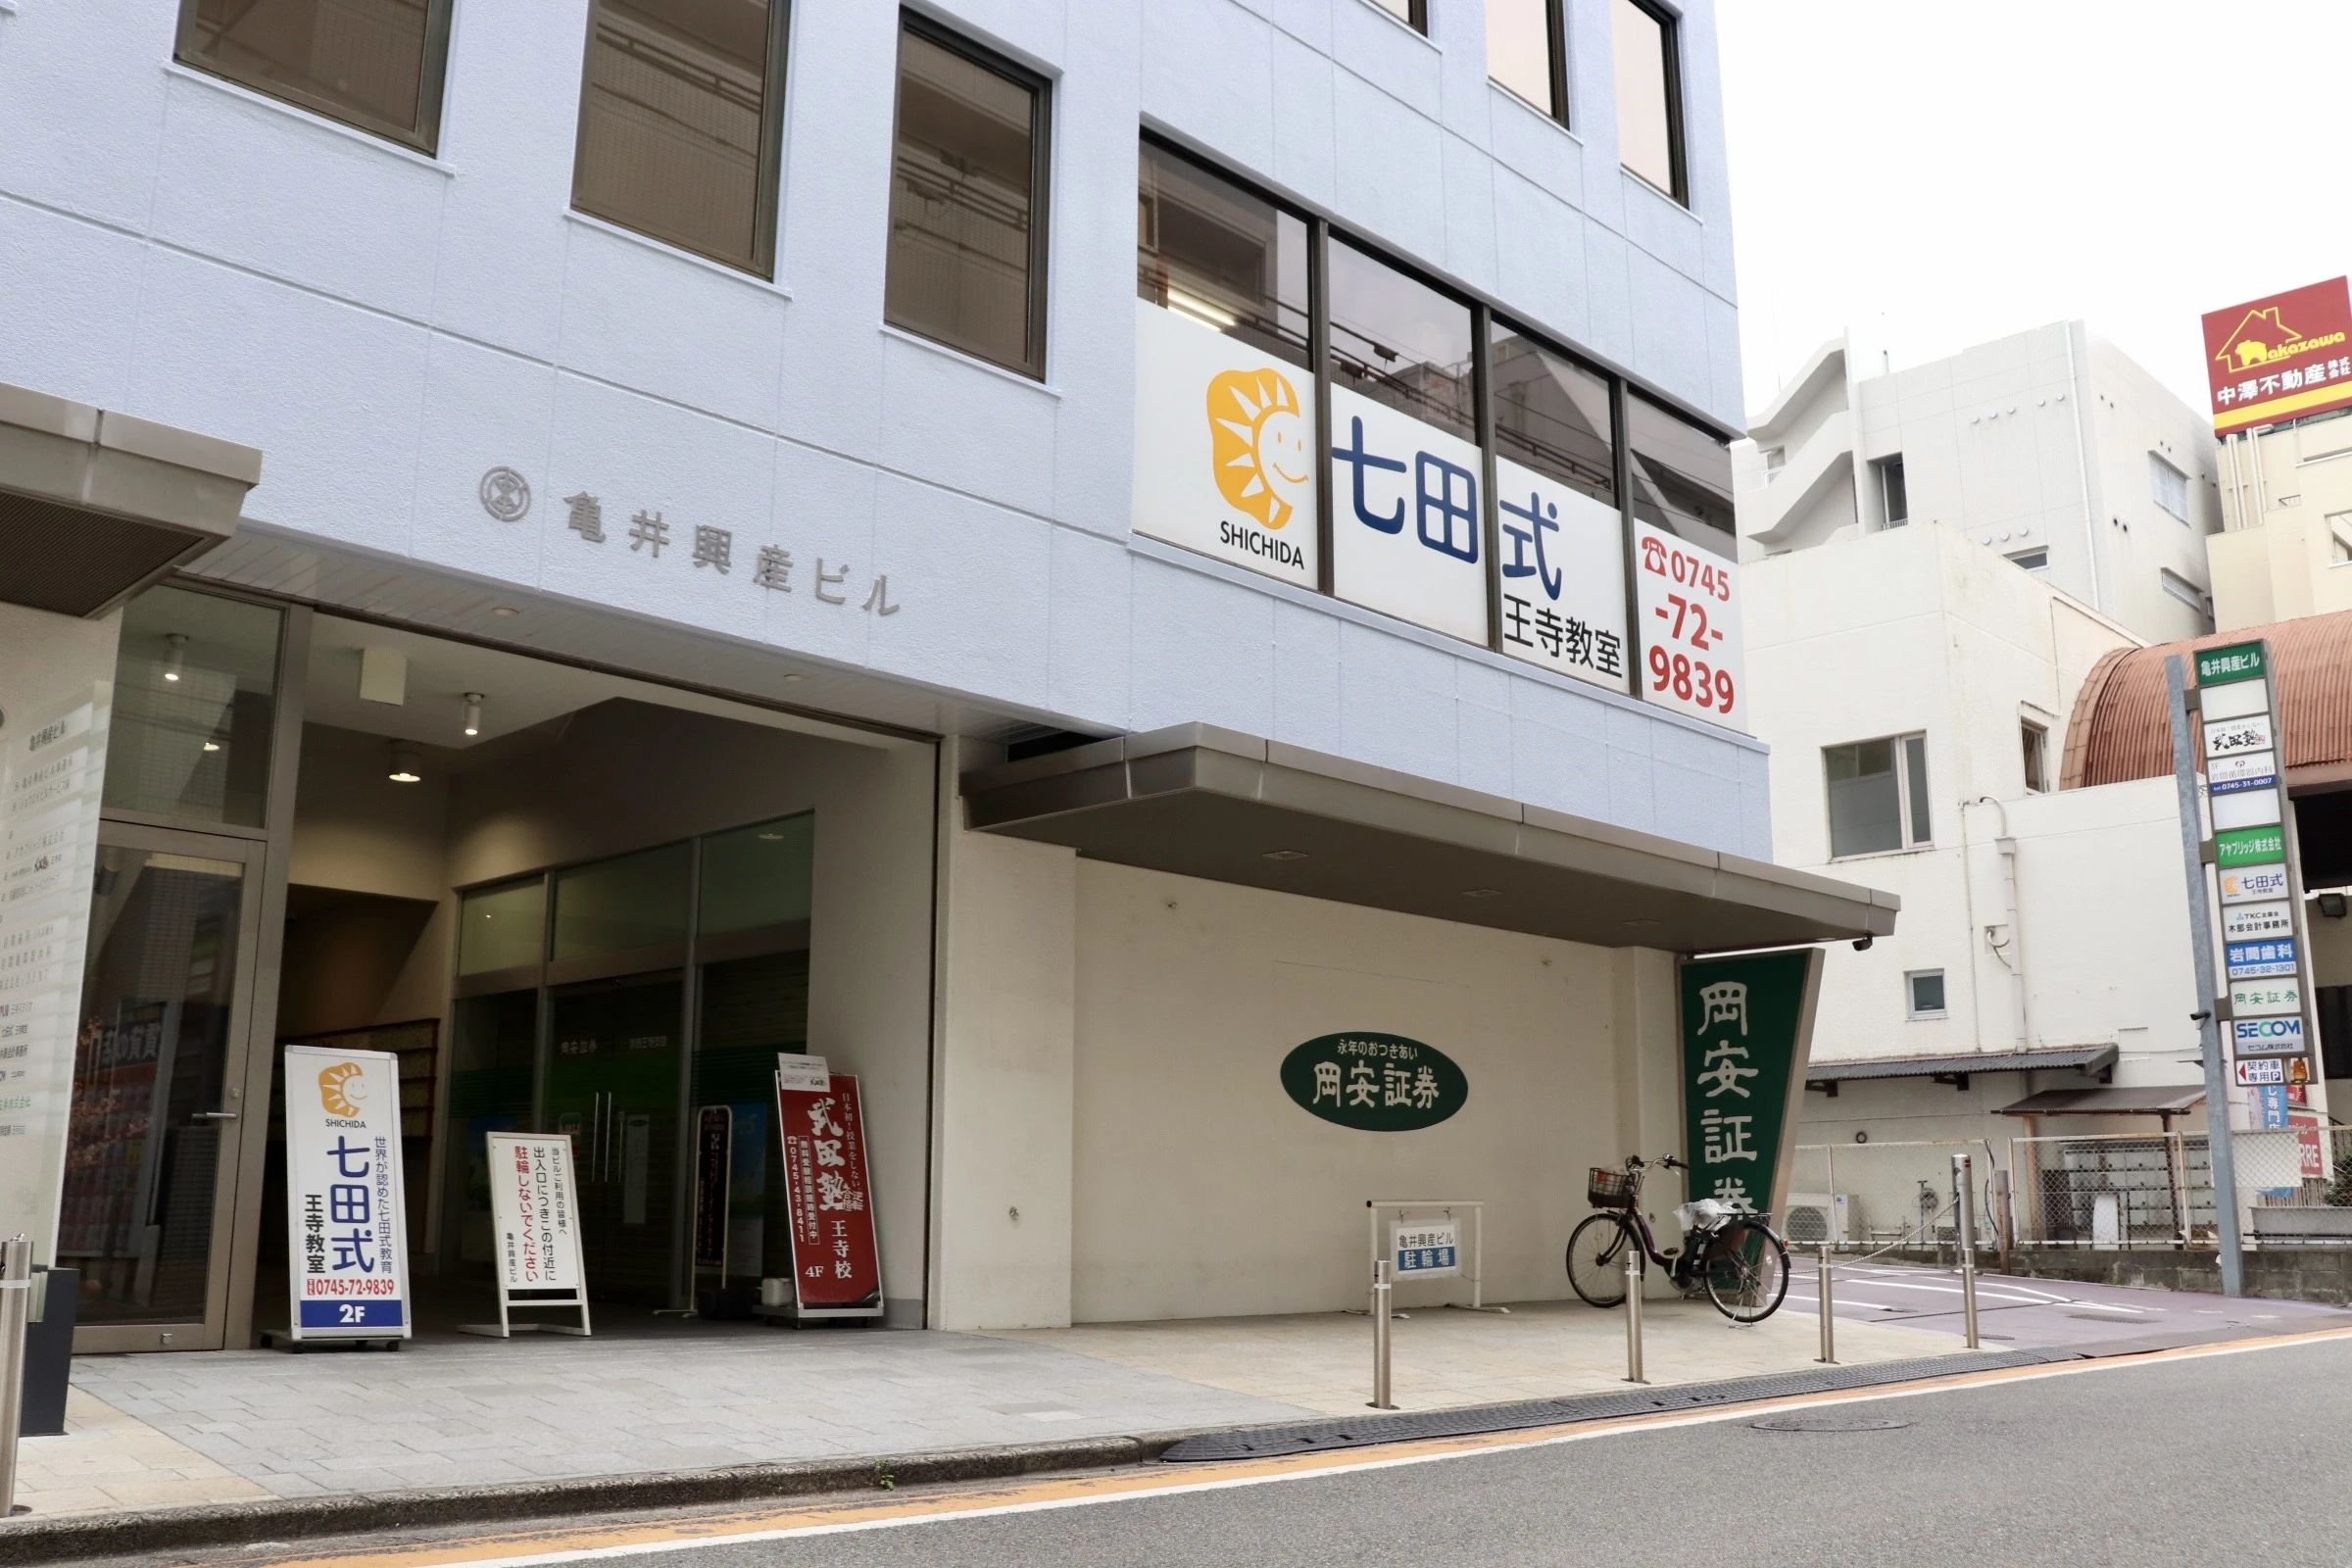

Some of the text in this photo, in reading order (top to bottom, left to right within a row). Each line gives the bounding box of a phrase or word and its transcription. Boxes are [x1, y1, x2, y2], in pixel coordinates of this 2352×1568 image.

[2217, 364, 2327, 405] 中澤不動産
[1331, 415, 1562, 601] 七田式
[563, 491, 900, 616] 亀井興産ビル
[1220, 520, 1304, 570] SHICHIDA
[1671, 552, 1732, 603] 0745
[1503, 593, 1623, 678] 王寺教室
[1648, 645, 1735, 714] 9839
[2201, 652, 2260, 676] 亀井興産ビル
[2220, 836, 2281, 857] アヤブリッジ株式会社
[2241, 872, 2283, 889] 七田式
[2234, 990, 2297, 1005] 岡安証券
[1337, 1039, 1418, 1060] 永年のおつきあい
[2236, 1020, 2300, 1038] SECOM
[1312, 1059, 1440, 1109] 岡安証券
[2247, 1060, 2279, 1071] 契約車
[325, 1118, 367, 1129] SHICHIDA
[1696, 981, 1759, 1221] 岡安証券
[326, 1135, 375, 1273] 七田式
[374, 1136, 393, 1274] 世界が認めた七田式教育
[514, 1146, 539, 1283] 駐輪しないでください
[533, 1146, 558, 1282] 出入口につきこの付近に
[305, 1194, 326, 1274] 王寺教室
[831, 1220, 853, 1279] 王寺校
[1398, 1232, 1456, 1250] 亀井興産ビル
[805, 1265, 824, 1278] 4F
[1403, 1248, 1450, 1270] 駐輪場
[316, 1278, 394, 1296] 0745-72-9839
[339, 1303, 366, 1323] 2F
